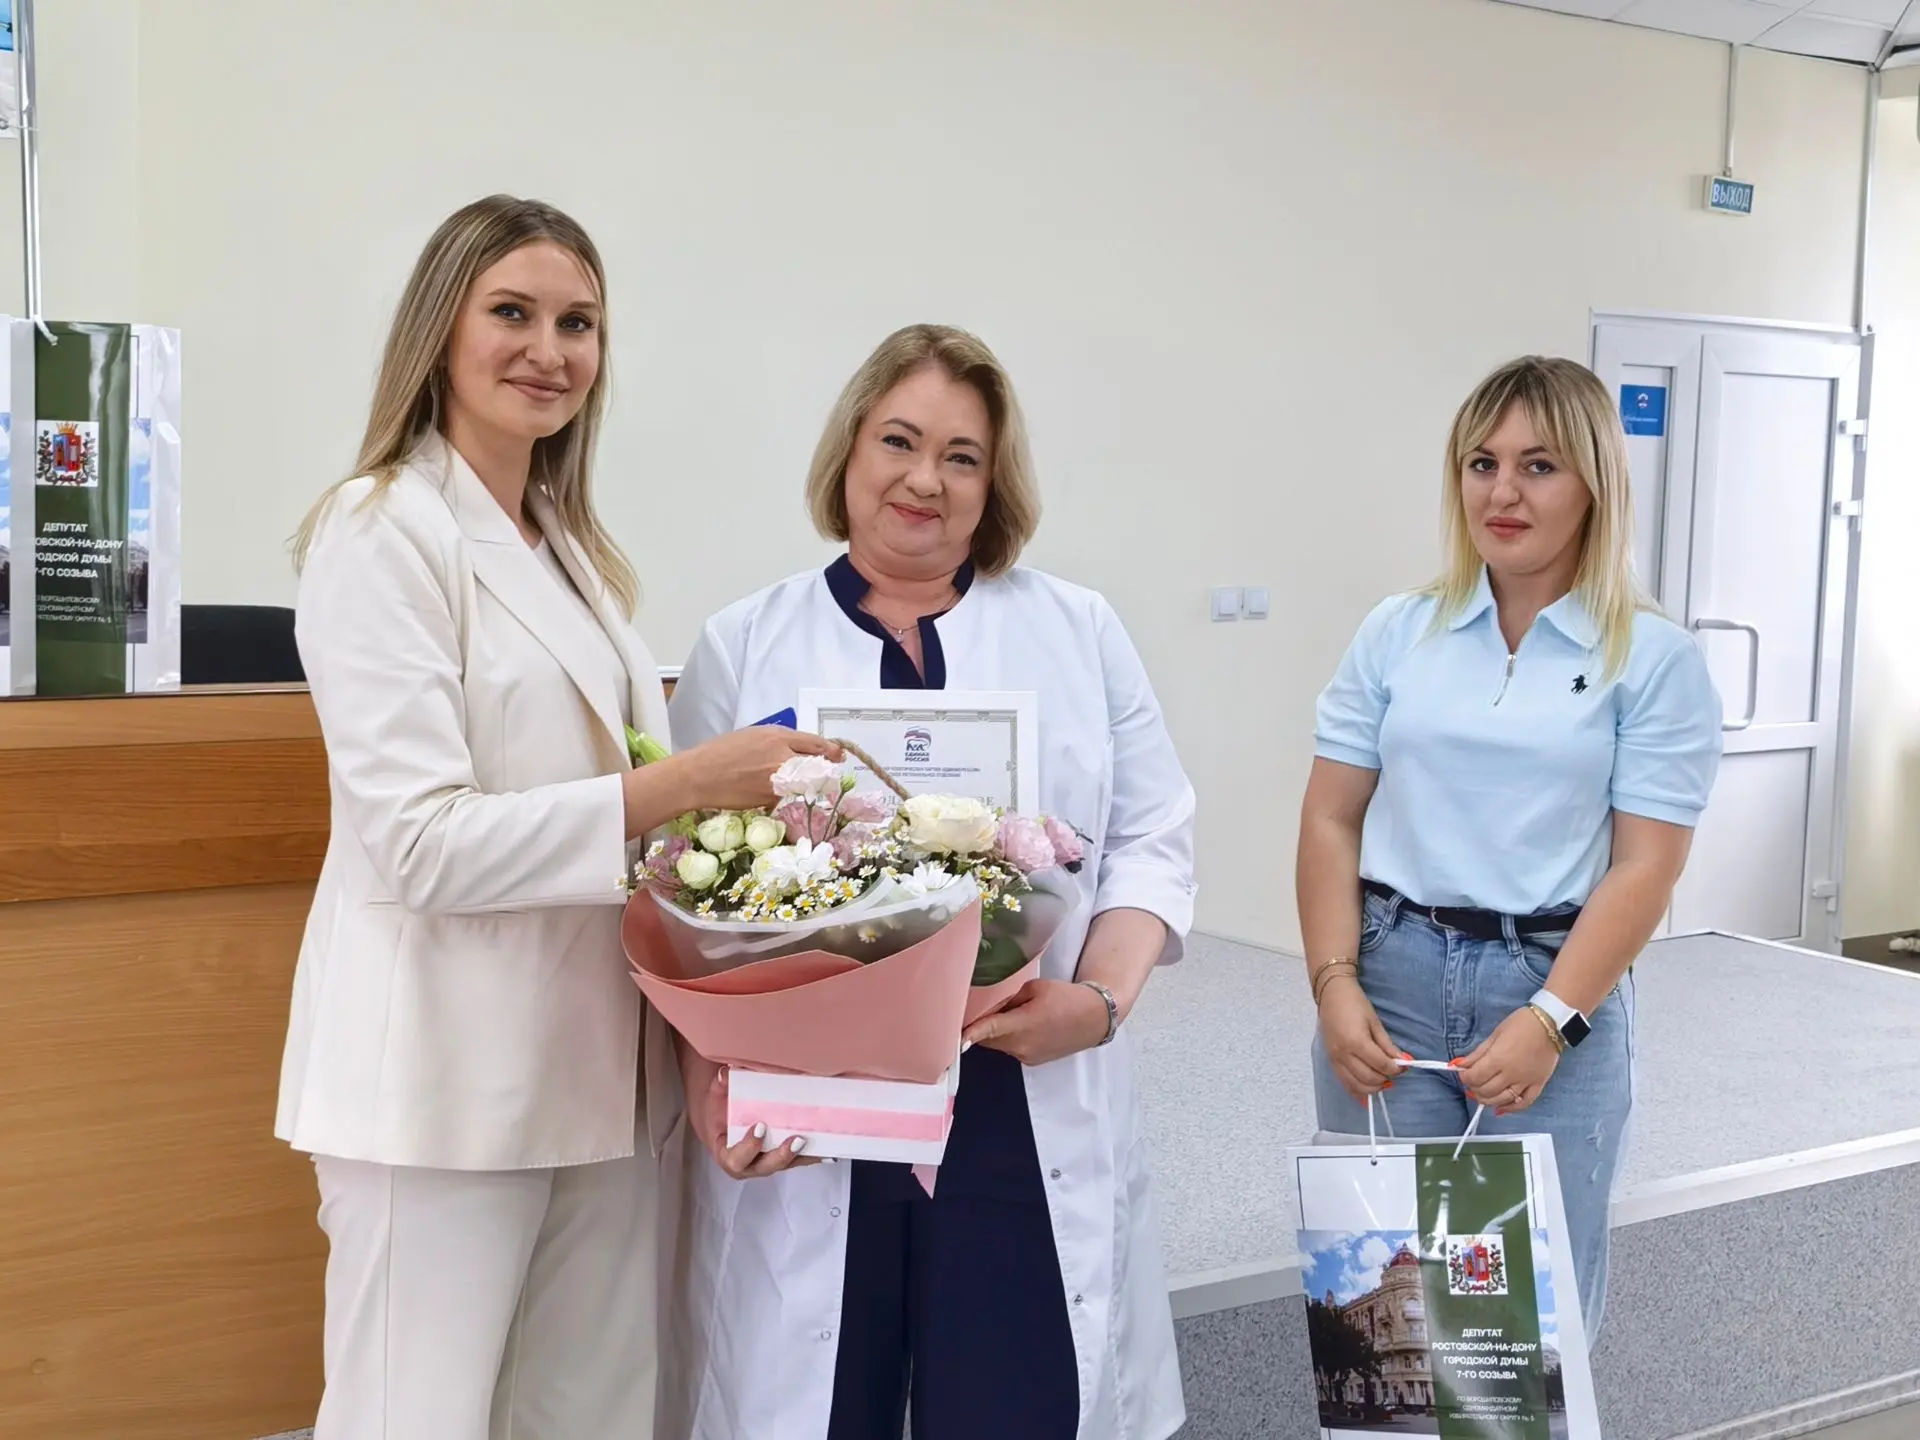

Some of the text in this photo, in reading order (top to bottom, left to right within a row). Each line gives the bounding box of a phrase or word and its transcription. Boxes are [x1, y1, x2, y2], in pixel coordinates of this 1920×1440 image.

[1712, 183, 1751, 210] ВЫХОД
[43, 522, 88, 532] ДЕПУТАТ
[35, 537, 123, 550] ОВСКОЙ-НА-ДОНУ
[36, 552, 112, 564] ОДСКОЙ ДУМЫ
[56, 568, 98, 578] СОЗЫВА
[1462, 1328, 1503, 1338] ДЕПУТАТ
[1431, 1341, 1537, 1353] РОСТОВСКОЙ-НА-ДОНУ
[1443, 1355, 1529, 1366] ГОРОДСКОЙ ДУМЫ
[1456, 1370, 1517, 1379] 7-ГО СОЗЫВА
